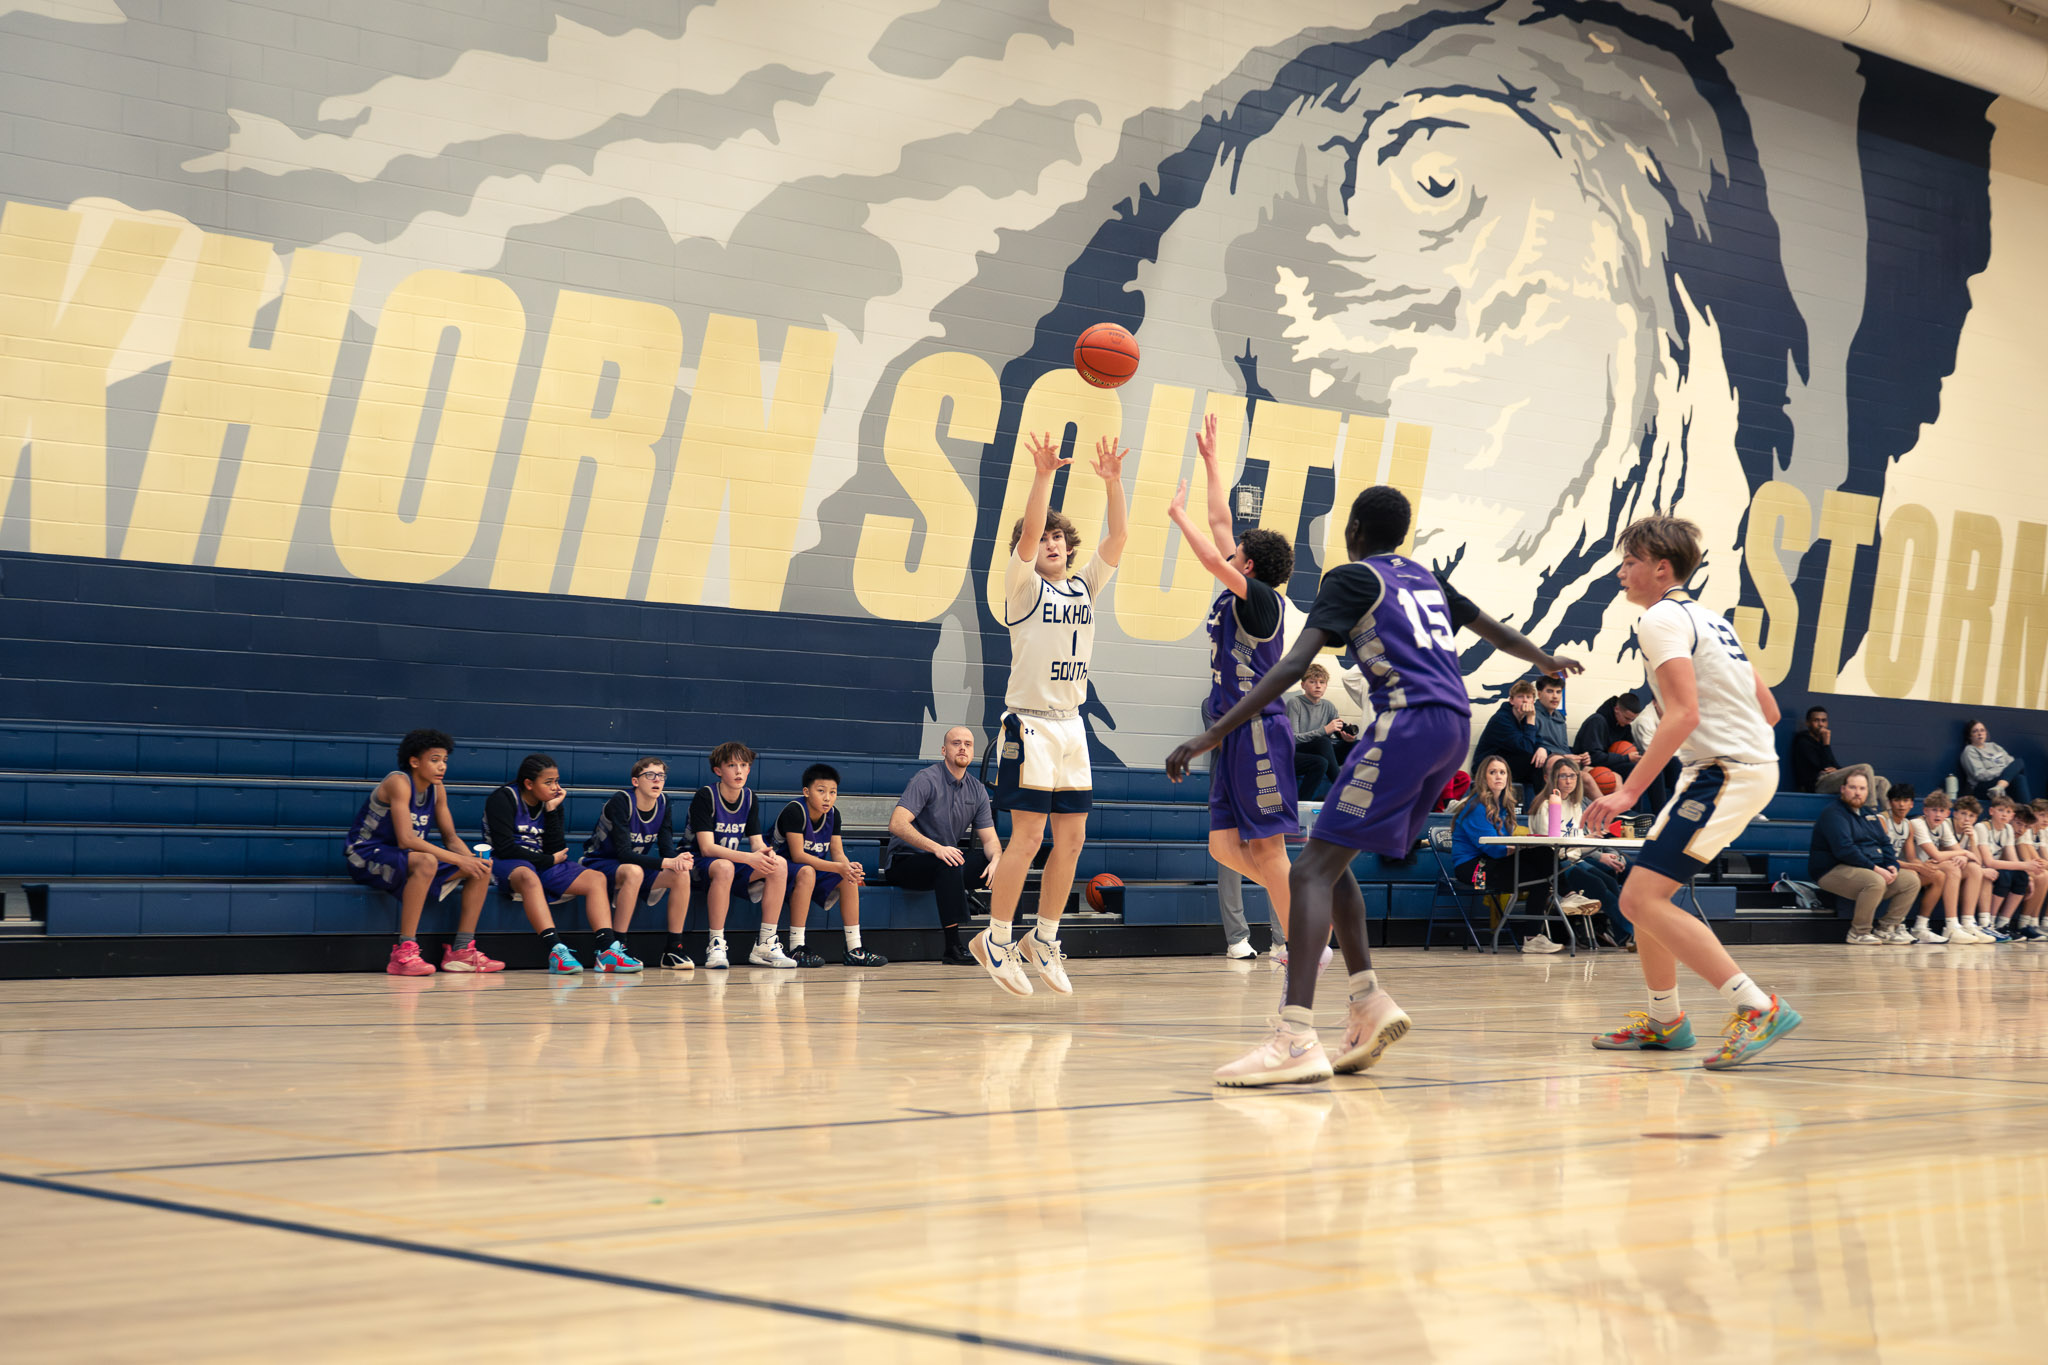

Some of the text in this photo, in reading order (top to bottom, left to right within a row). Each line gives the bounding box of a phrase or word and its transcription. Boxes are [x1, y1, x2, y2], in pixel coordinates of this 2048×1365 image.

[1397, 587, 1456, 652] 15
[1072, 630, 1077, 656] 1
[1050, 661, 1088, 681] SOUTH
[715, 822, 747, 834] EAST
[629, 832, 658, 844] EAST
[719, 836, 739, 851] 10
[803, 839, 831, 853] EAST
